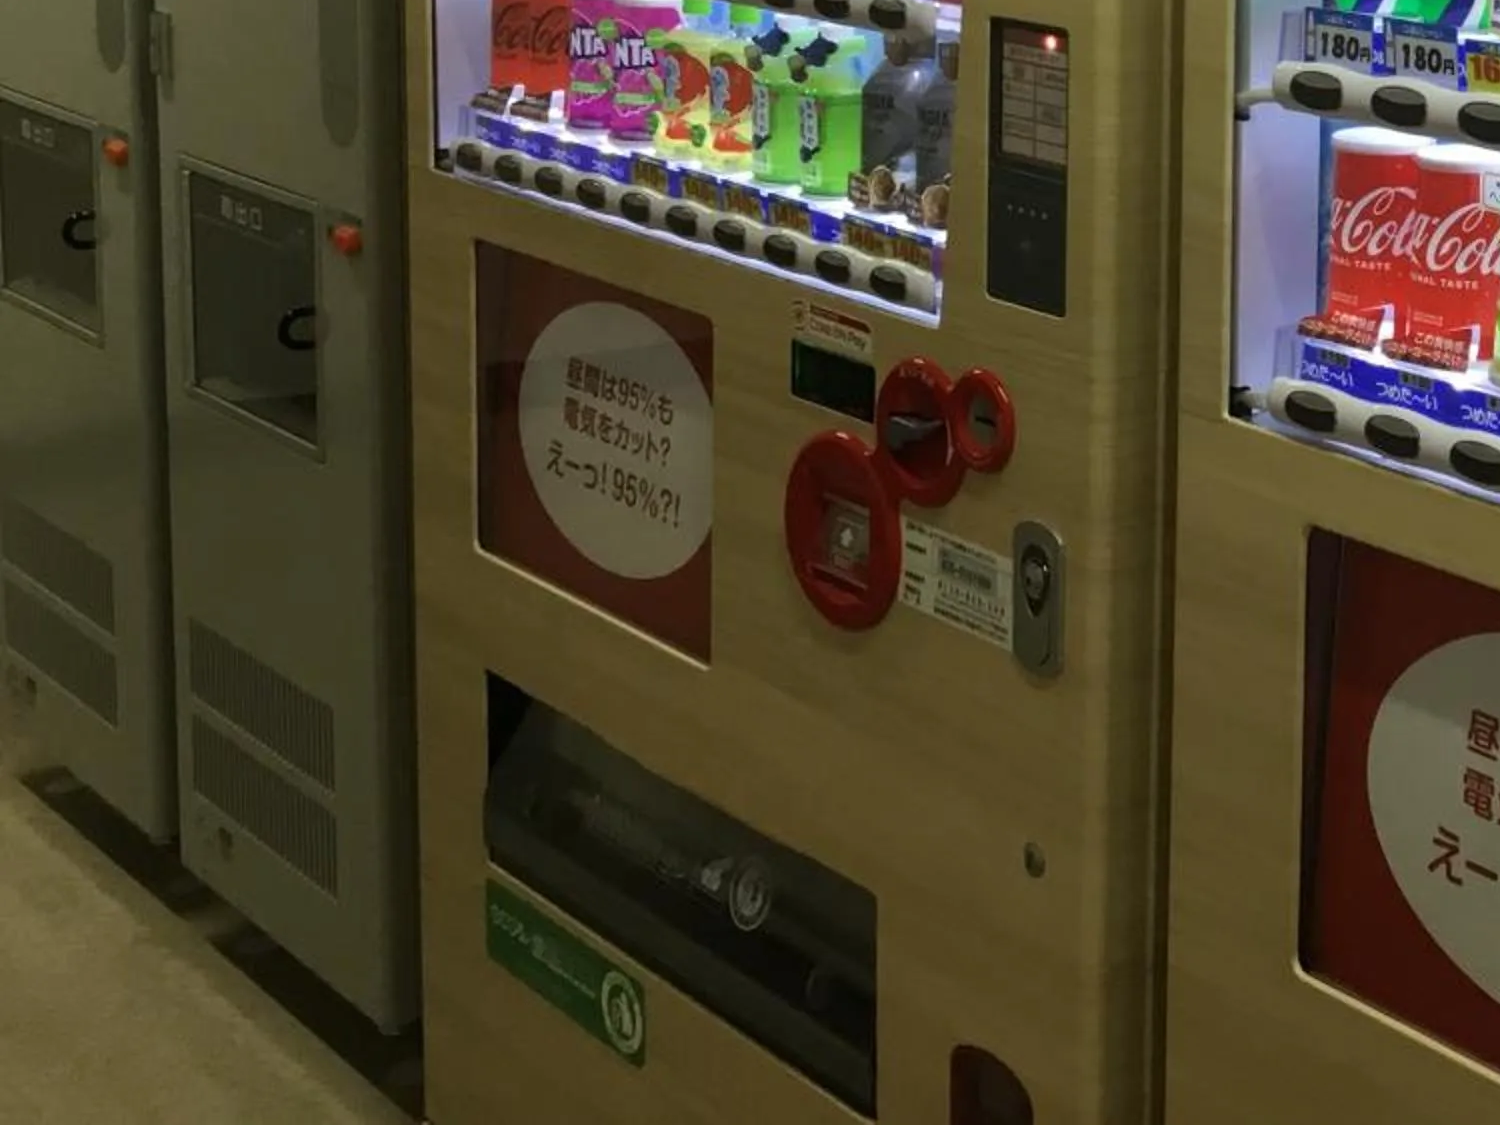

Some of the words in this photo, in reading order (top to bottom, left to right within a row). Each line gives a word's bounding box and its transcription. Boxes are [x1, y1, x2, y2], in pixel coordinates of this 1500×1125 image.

[1321, 32, 1370, 63] 180円
[1402, 43, 1455, 75] 180円
[567, 356, 674, 425] 昼間は95%も
[564, 396, 671, 467] 電気をカット?
